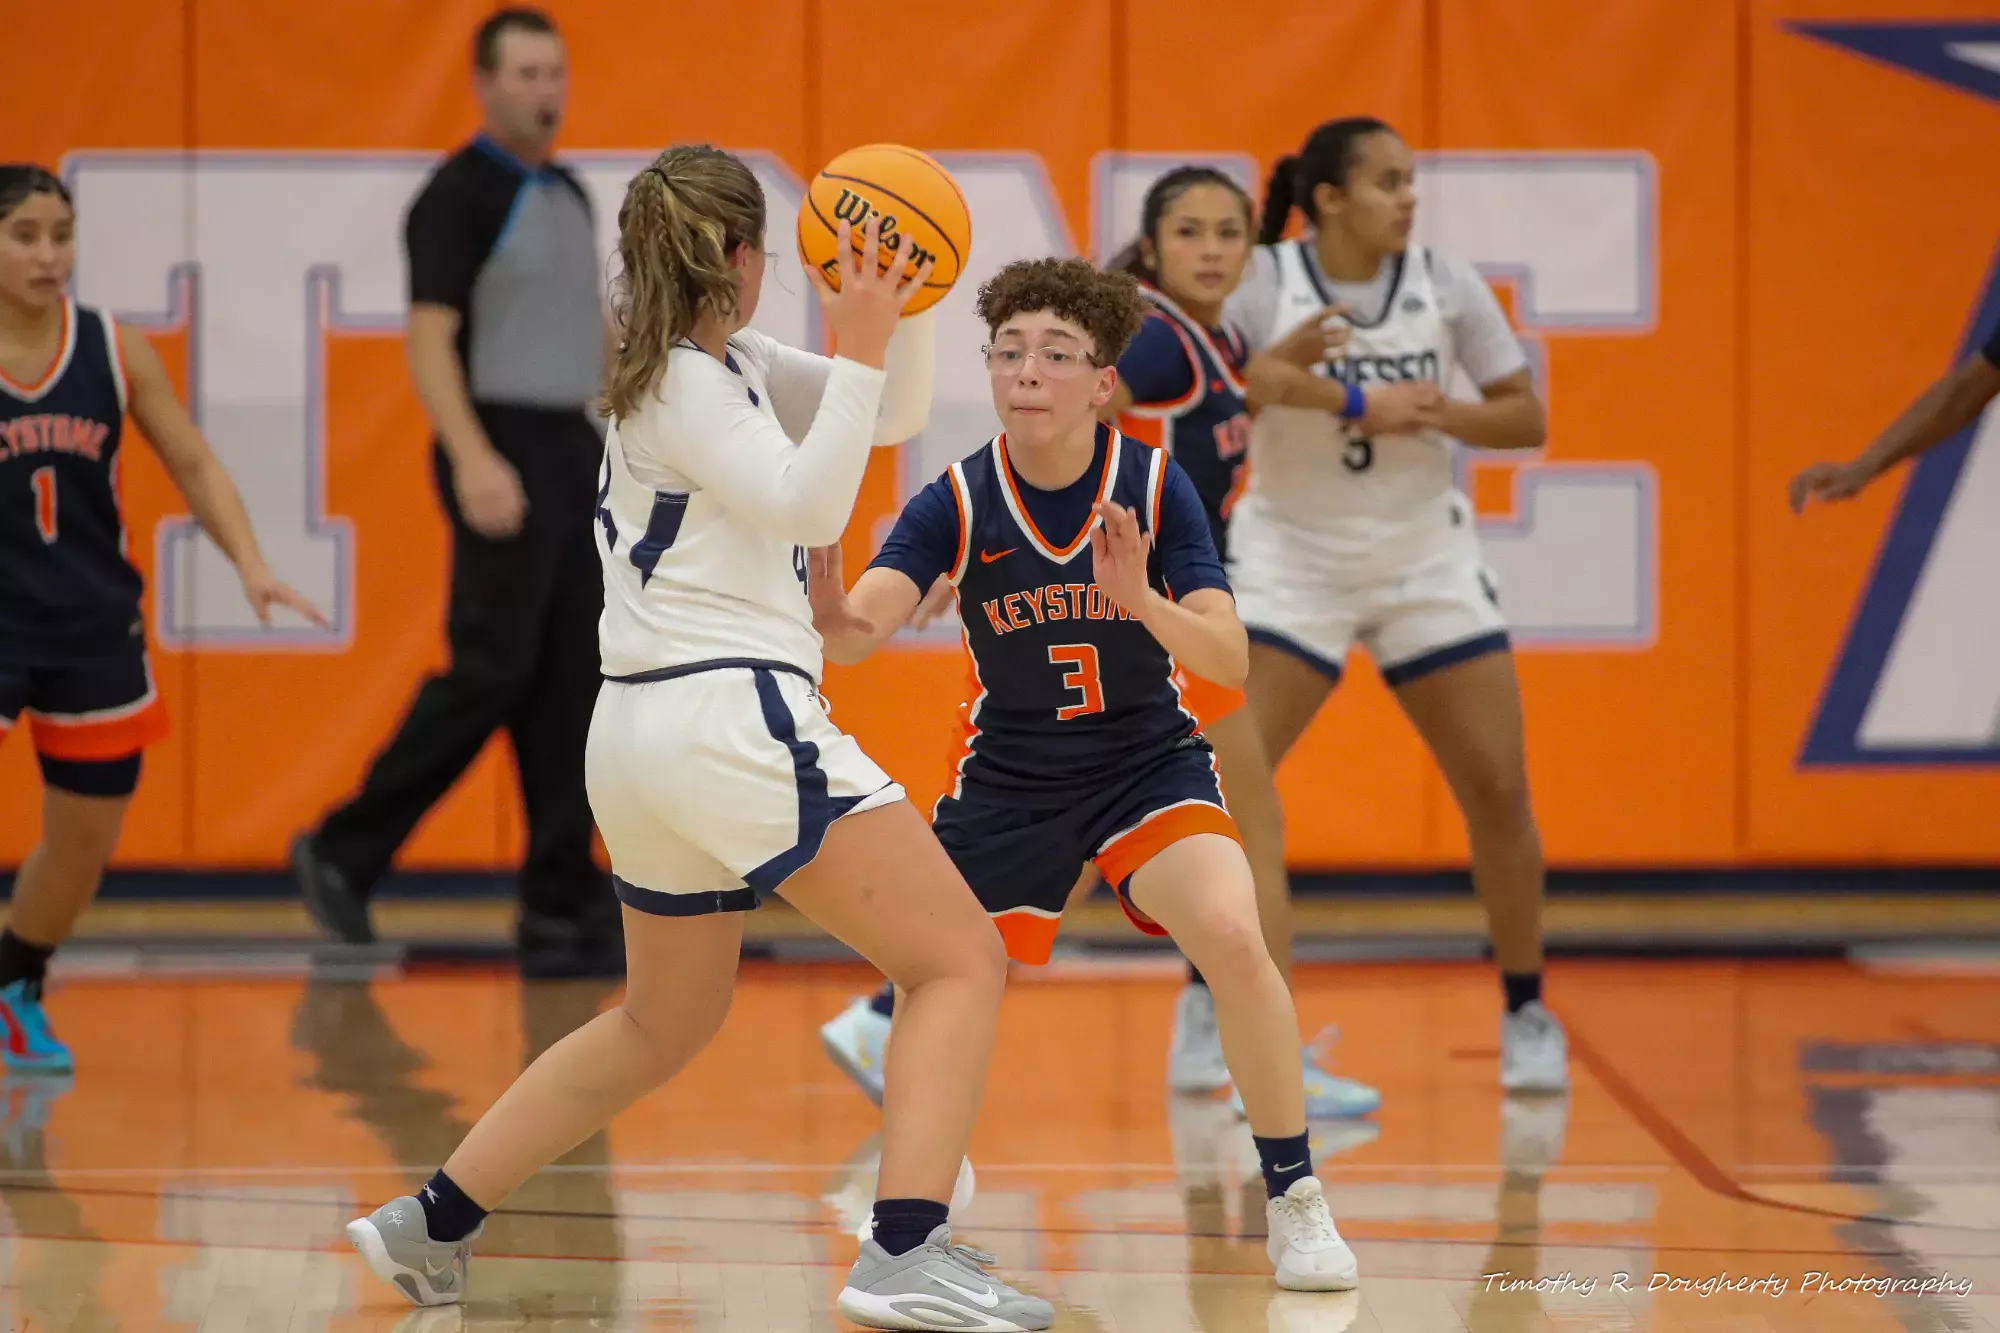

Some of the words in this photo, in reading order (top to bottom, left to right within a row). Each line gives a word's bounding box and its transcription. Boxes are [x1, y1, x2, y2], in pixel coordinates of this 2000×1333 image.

[834, 187, 937, 270] Wilsn
[31, 466, 58, 544] 1
[982, 583, 1141, 635] KEYSTON
[1048, 643, 1105, 720] 3
